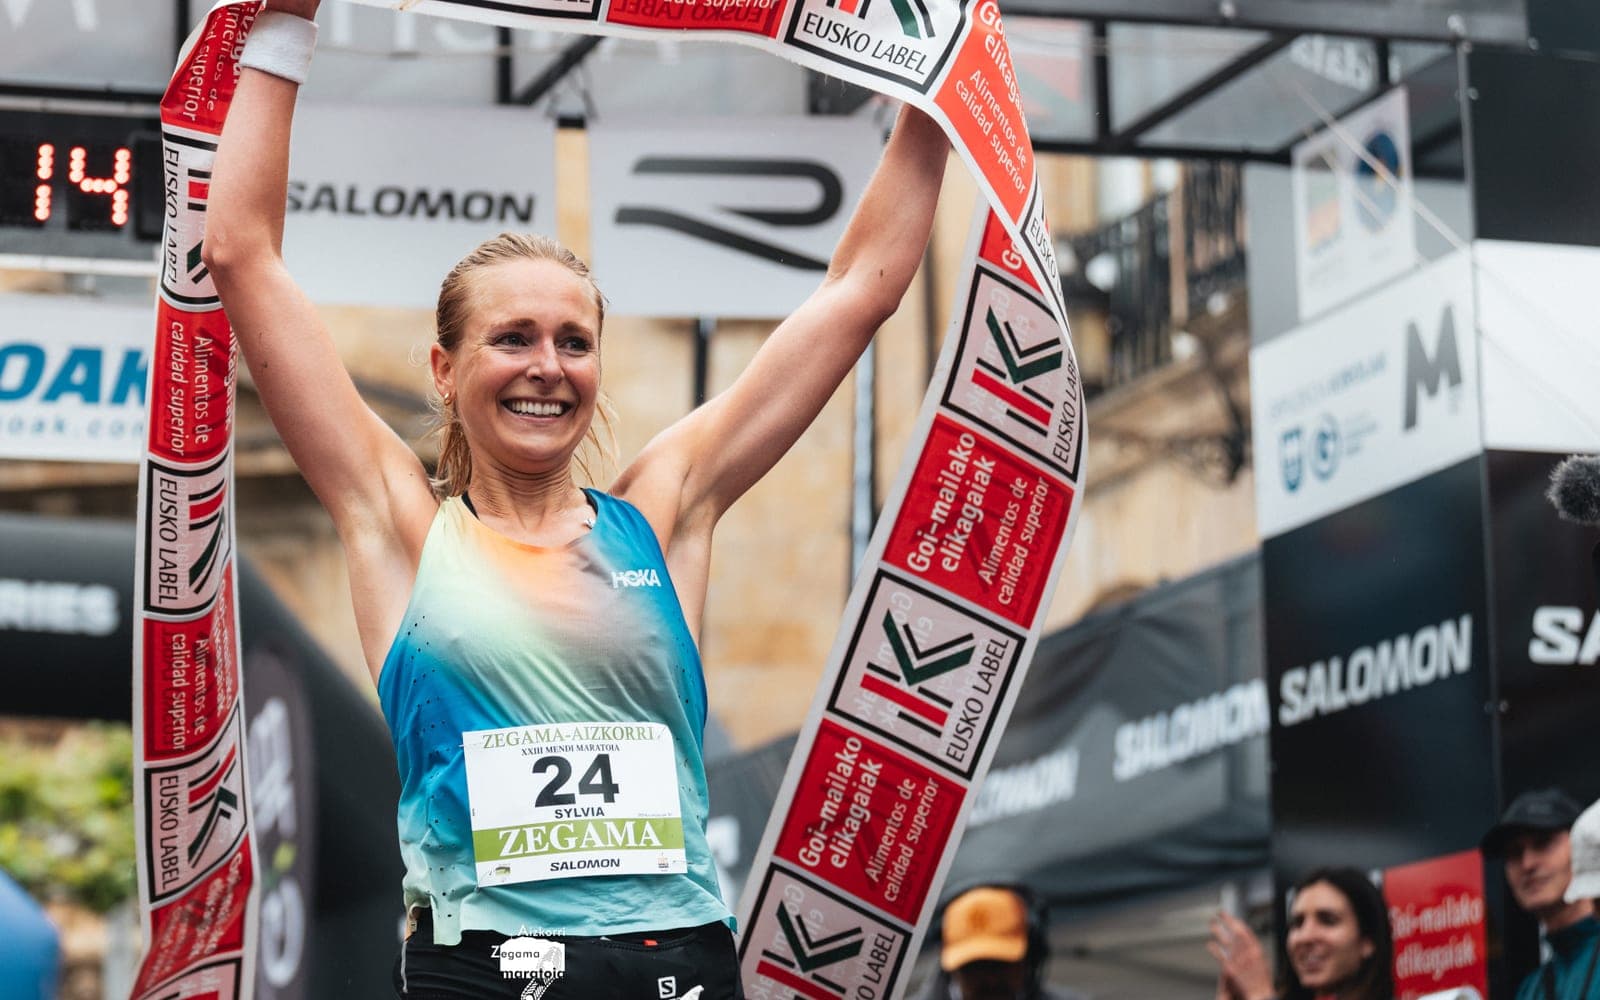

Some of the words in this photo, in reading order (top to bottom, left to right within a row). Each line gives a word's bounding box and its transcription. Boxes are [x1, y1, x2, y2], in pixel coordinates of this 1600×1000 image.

[802, 13, 870, 53] EUSKO
[871, 40, 929, 75] LABEL
[955, 79, 993, 135] calidad
[990, 133, 1026, 194] superior
[969, 69, 1017, 148] Alimentos
[1016, 143, 1027, 169] de
[34, 143, 131, 226] 14
[288, 183, 535, 224] SALOMON
[171, 321, 189, 384] calidad
[194, 335, 213, 420] Alimentos
[170, 389, 190, 456] superior
[195, 423, 213, 444] de
[1052, 401, 1077, 464] EUSKO
[1068, 350, 1082, 399] LAB
[158, 477, 178, 542] EUSKO
[906, 432, 976, 573] Goi-mailako
[940, 455, 997, 573] elikagaiak
[978, 499, 1020, 585] Alimentos
[1013, 476, 1029, 499] de
[998, 545, 1029, 606] calidad
[1023, 475, 1051, 546] superior
[158, 550, 178, 605] LABEL
[611, 568, 662, 589] HOKA
[171, 633, 189, 687] calidad
[194, 638, 210, 716] Alimentos
[1278, 613, 1474, 727] SALOMON
[167, 692, 186, 751] superior
[946, 697, 985, 763] EUSKO
[972, 637, 1010, 696] LABEL
[1113, 678, 1269, 782] SALOMON
[483, 726, 655, 749] ZEGAMA-AIZKORRI
[521, 746, 543, 756] XXIII
[545, 745, 574, 754] MENDI
[576, 744, 620, 753] MARATOIA
[159, 775, 179, 831] EUSKO
[532, 754, 620, 808] 24
[554, 807, 605, 819] SYLVIA
[798, 736, 863, 867] Goi-mailako
[830, 758, 884, 869] elikagaiak
[160, 836, 180, 890] LABEL
[498, 820, 663, 857] ZEGAMA
[864, 801, 909, 882] Alimentos
[900, 778, 917, 800] de
[883, 844, 914, 903] calidad
[906, 777, 940, 845] superior
[550, 858, 620, 872] SALOMON
[860, 931, 897, 984] LABEL
